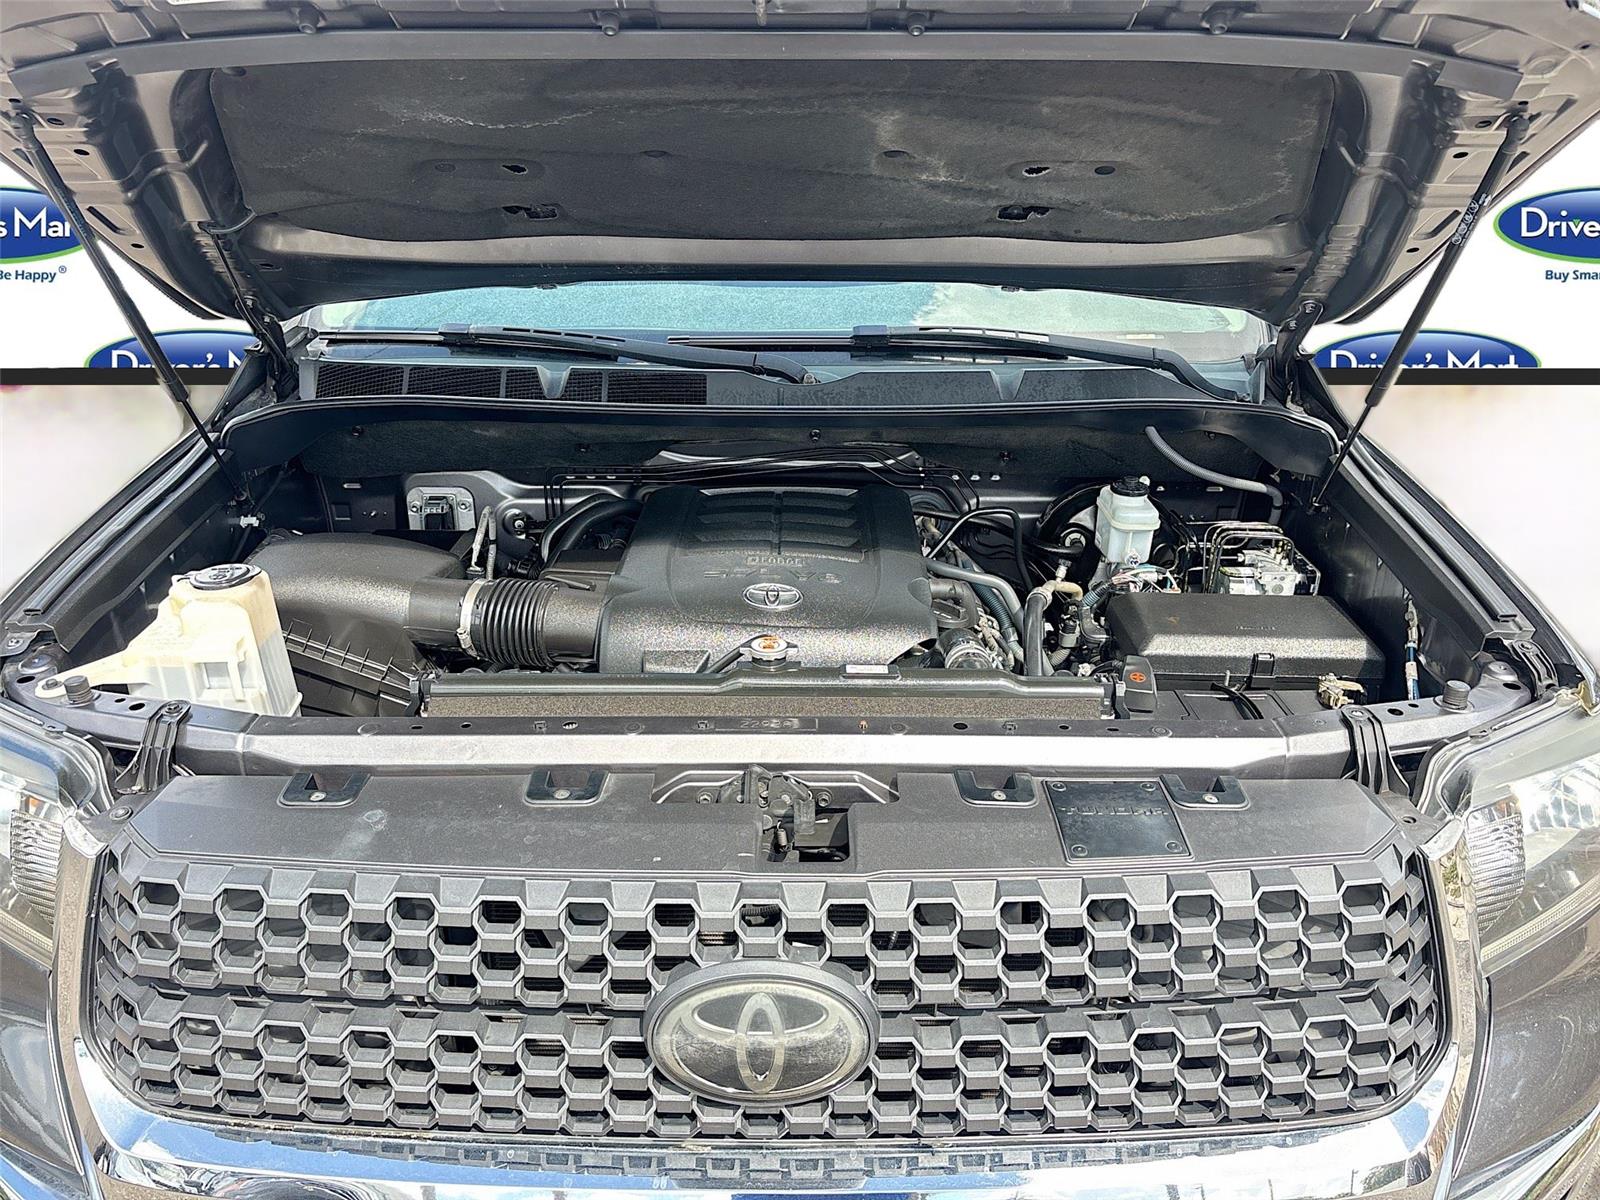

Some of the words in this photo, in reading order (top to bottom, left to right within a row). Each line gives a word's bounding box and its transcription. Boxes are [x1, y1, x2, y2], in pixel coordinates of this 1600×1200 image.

[14, 206, 71, 237] Mar
[15, 270, 57, 283] Happy
[1545, 270, 1570, 283] Buy
[1572, 270, 1600, 280] Sma
